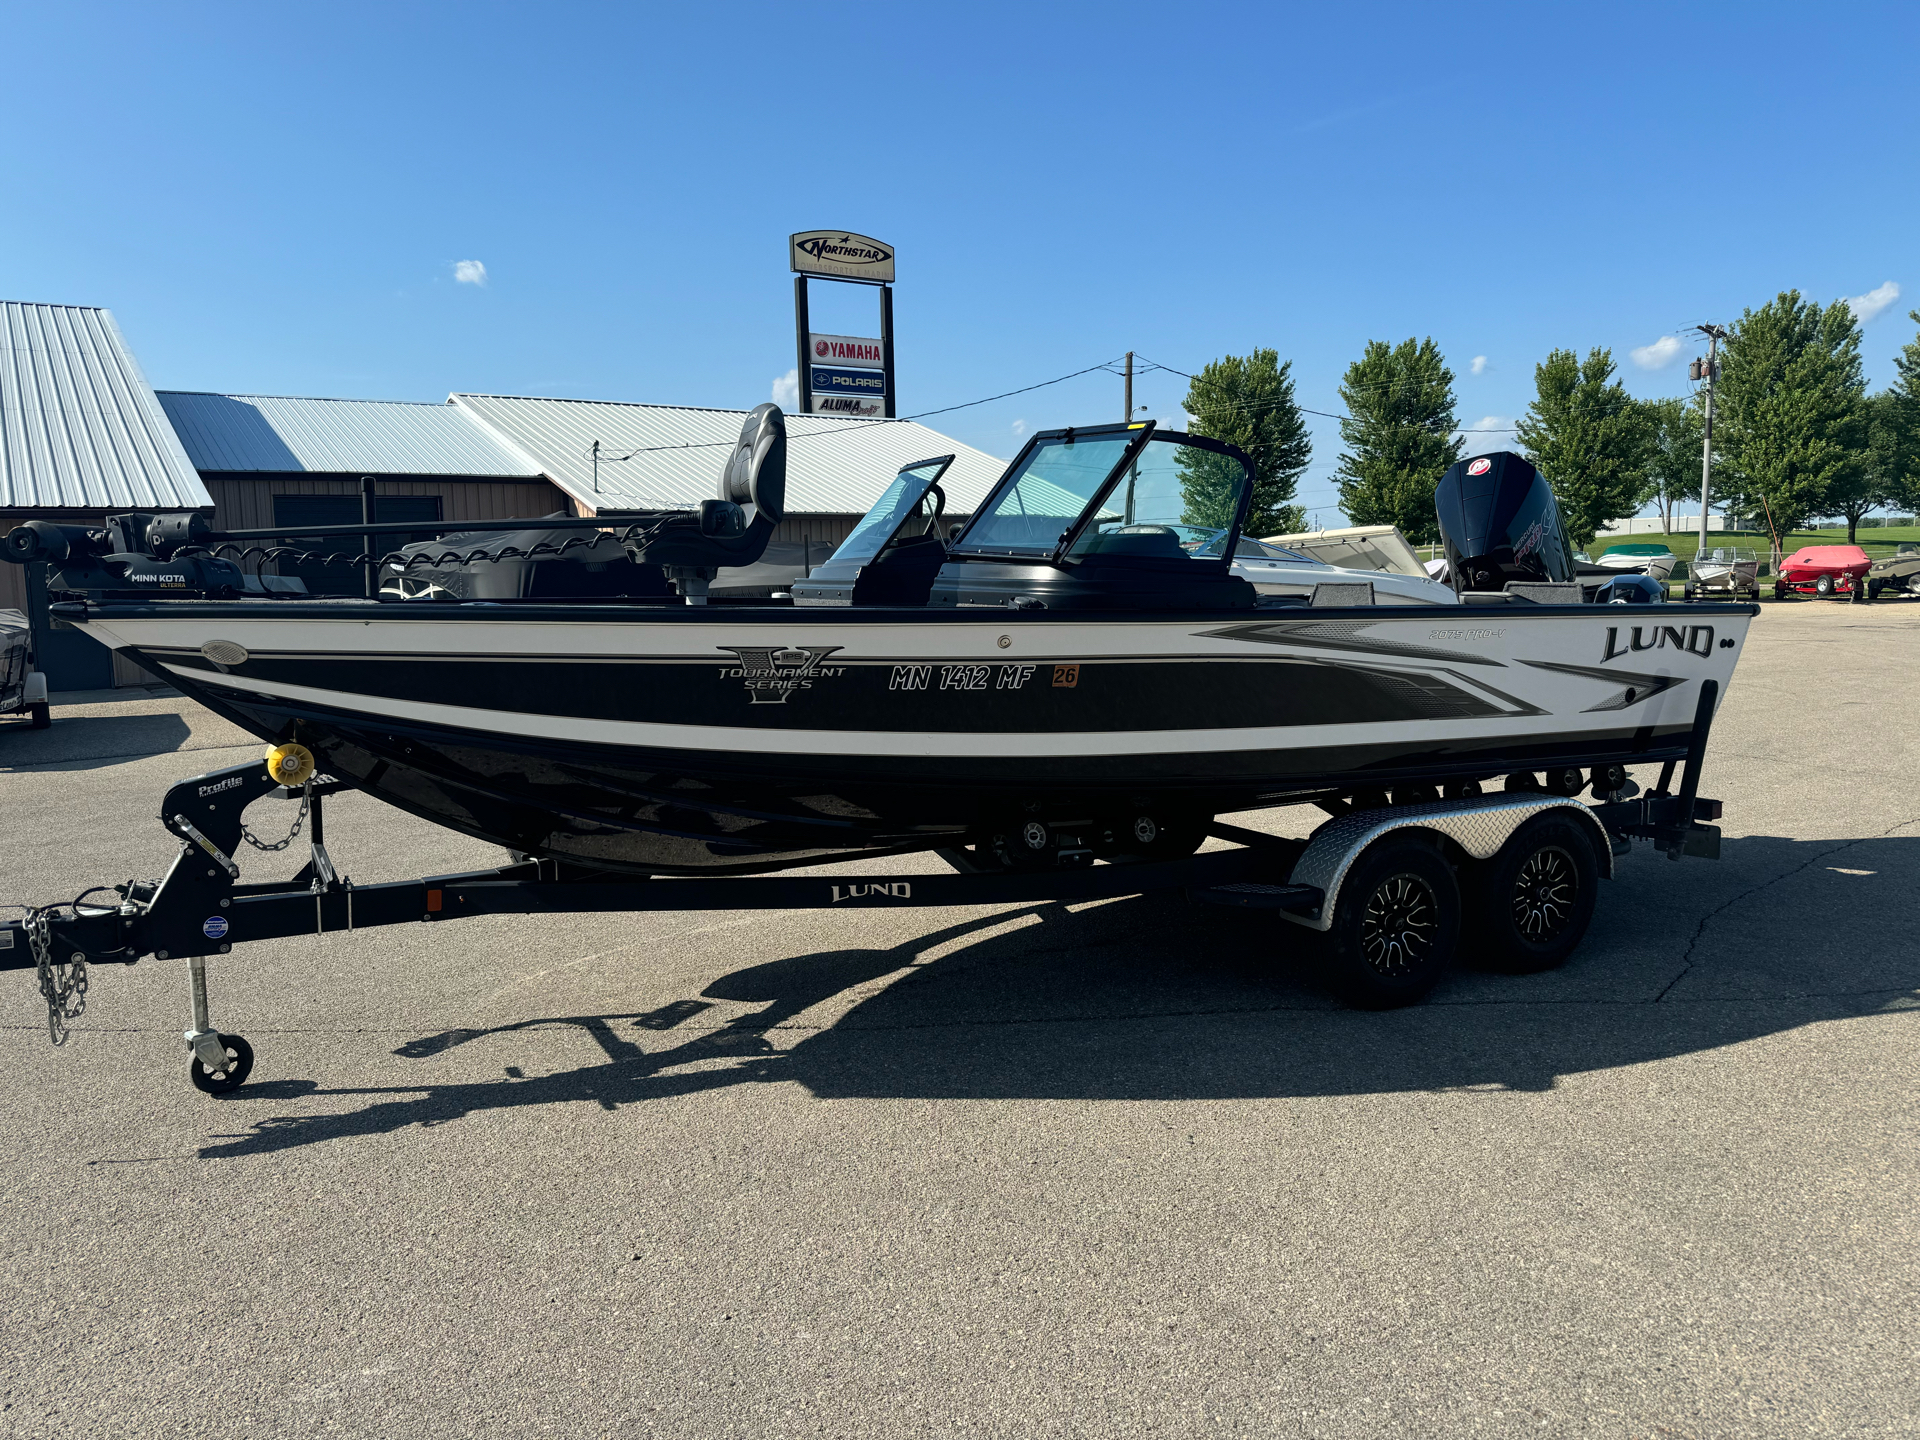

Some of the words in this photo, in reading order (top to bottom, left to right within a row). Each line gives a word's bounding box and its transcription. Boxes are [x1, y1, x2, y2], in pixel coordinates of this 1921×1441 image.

[810, 239, 880, 263] NORTHSTAR
[796, 261, 853, 275] POWERSPORTS
[864, 269, 894, 280] MARINE
[829, 342, 881, 361] YAMAHA
[832, 376, 883, 388] POLARIS
[1512, 520, 1536, 554] MERCURY
[132, 574, 157, 582] MINN
[159, 574, 185, 582] KOTA
[1429, 629, 1464, 640] 2075
[1464, 628, 1507, 641] PRO-V
[1599, 624, 1715, 664] LUND
[718, 667, 847, 680] TOURNAMENT
[889, 665, 932, 690] MN
[939, 665, 990, 690] 1412
[996, 664, 1036, 690] MF
[1053, 667, 1076, 684] 26
[743, 680, 814, 690] SERIES
[198, 777, 243, 795] Profile
[831, 882, 911, 903] LUND
